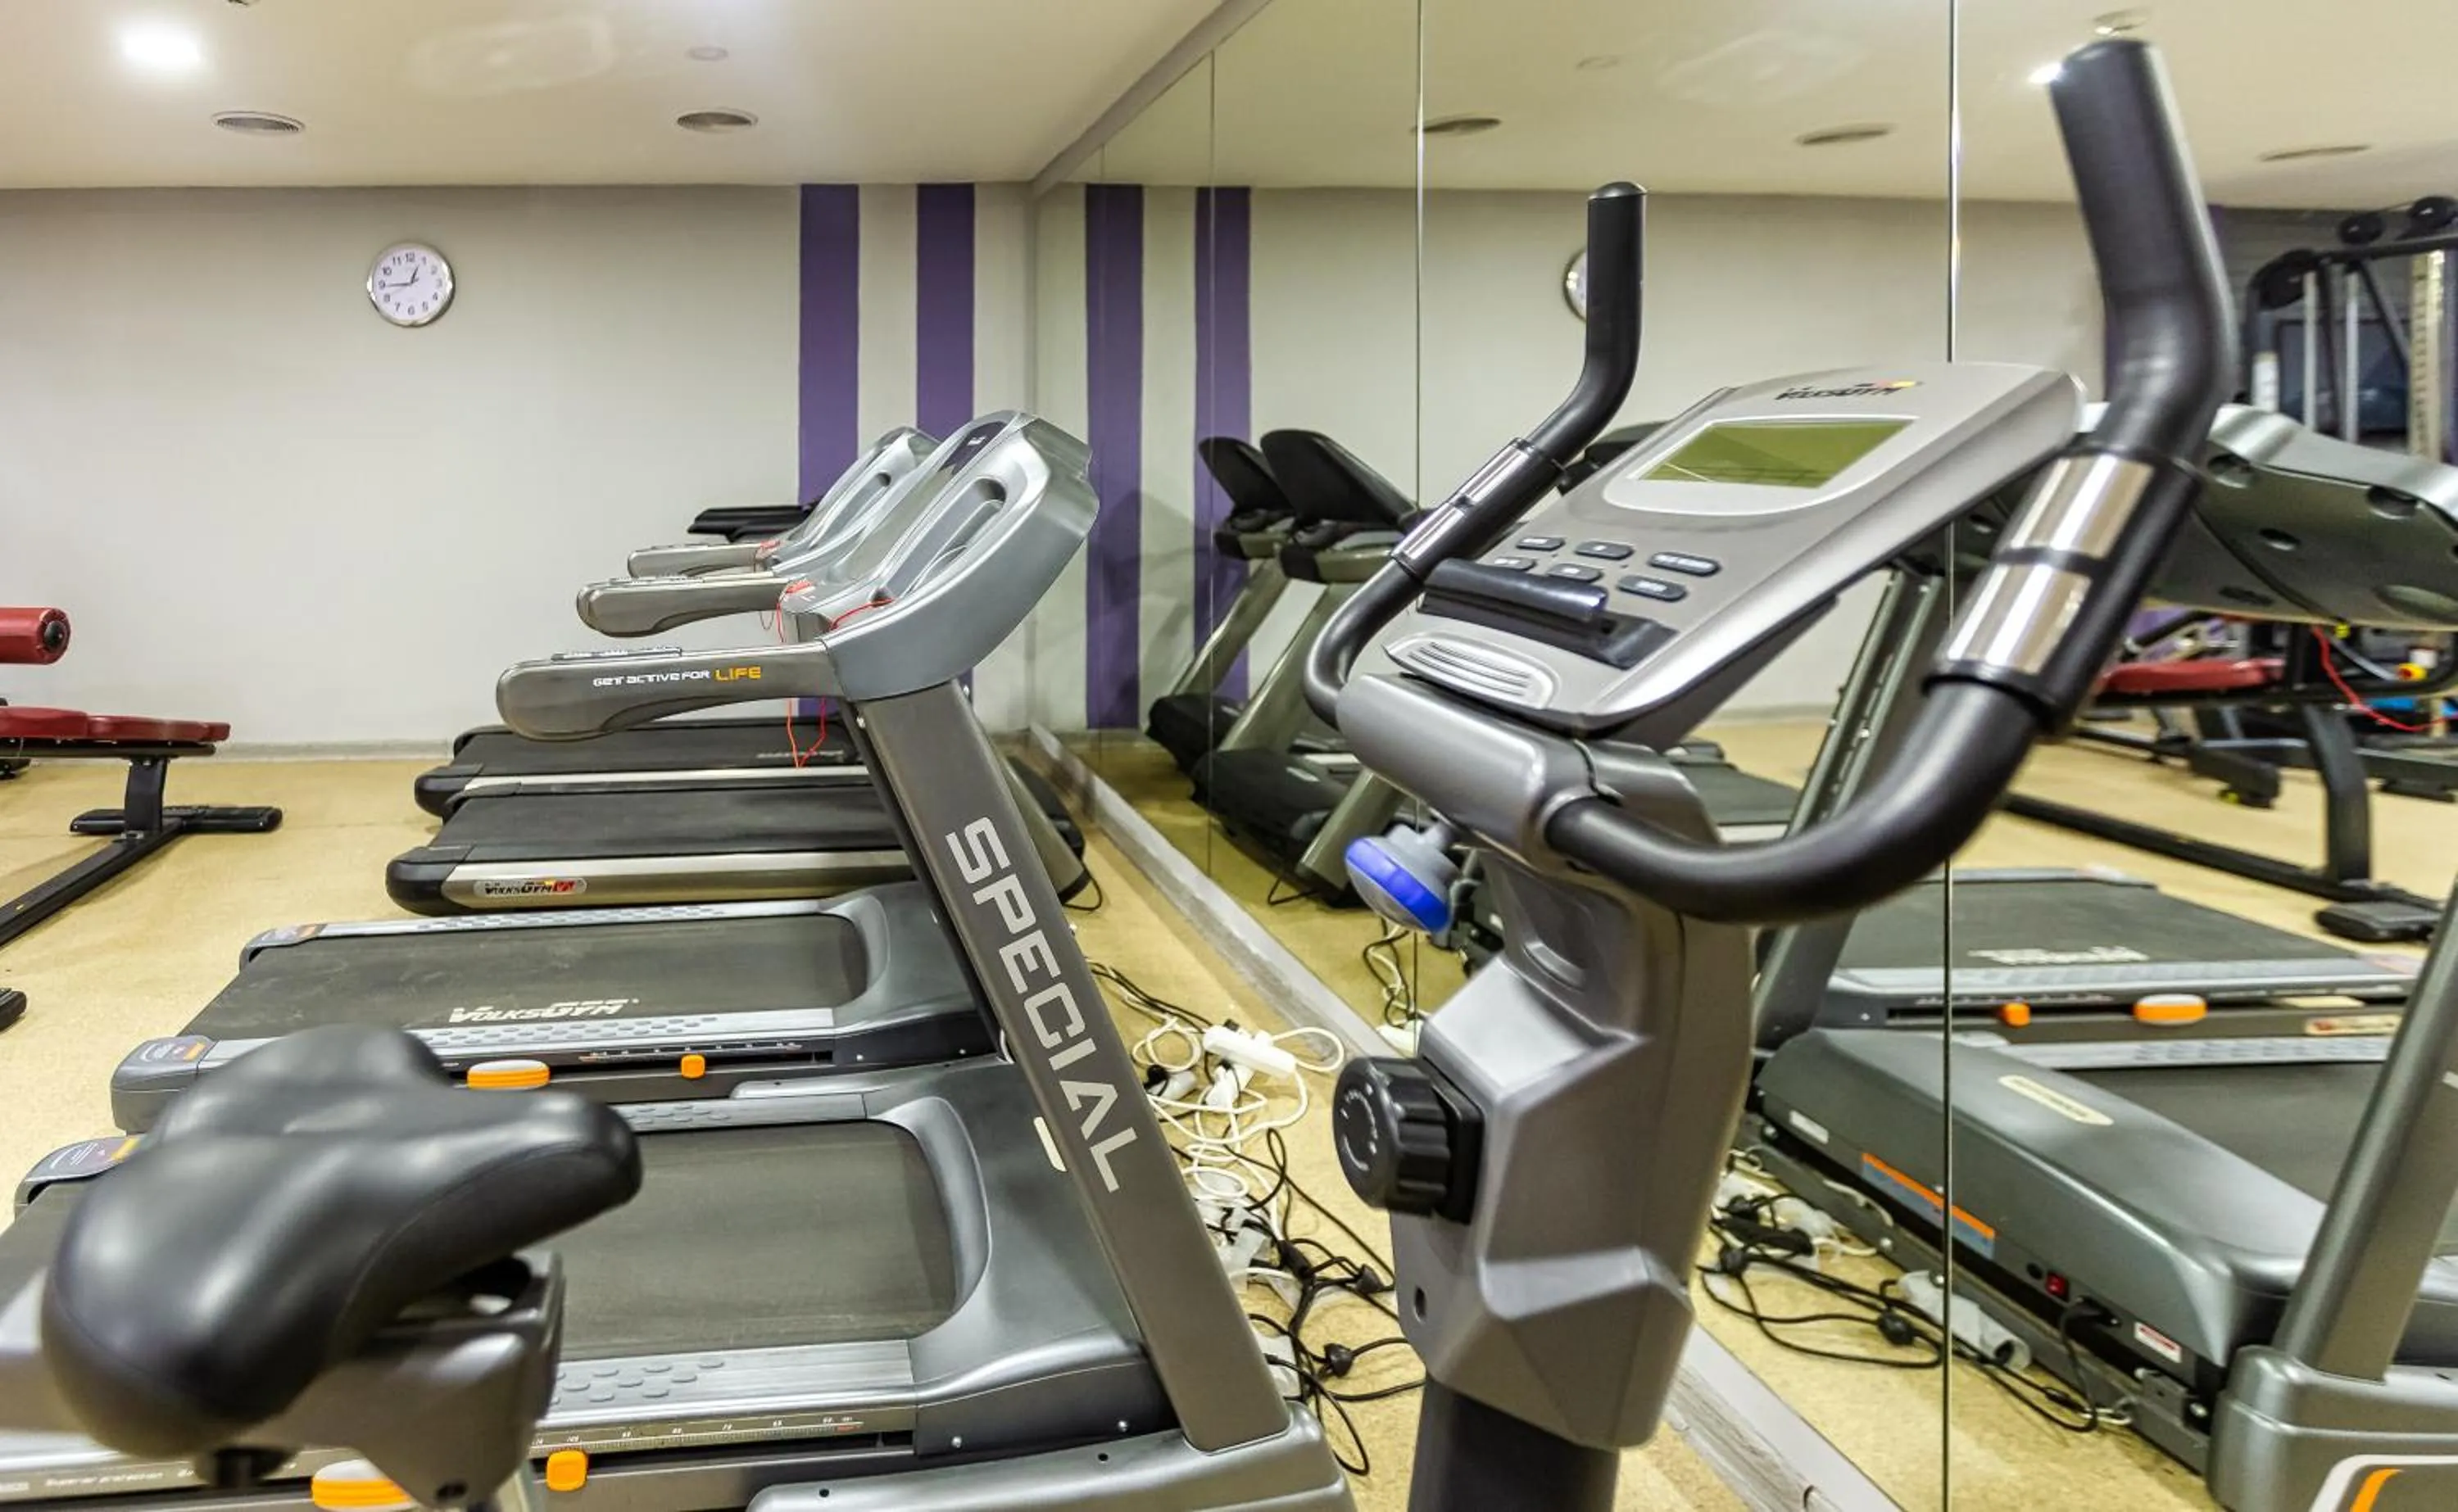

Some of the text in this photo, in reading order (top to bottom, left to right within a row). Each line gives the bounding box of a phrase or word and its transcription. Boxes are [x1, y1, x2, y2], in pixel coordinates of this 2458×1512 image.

[392, 256, 401, 266] 11
[406, 251, 415, 263] 12
[382, 266, 392, 276] 10
[394, 301, 401, 311] 7
[592, 675, 625, 687] GET
[681, 669, 711, 681] FOR
[714, 666, 762, 681] LIFE
[946, 816, 1137, 1193] SPECIAL
